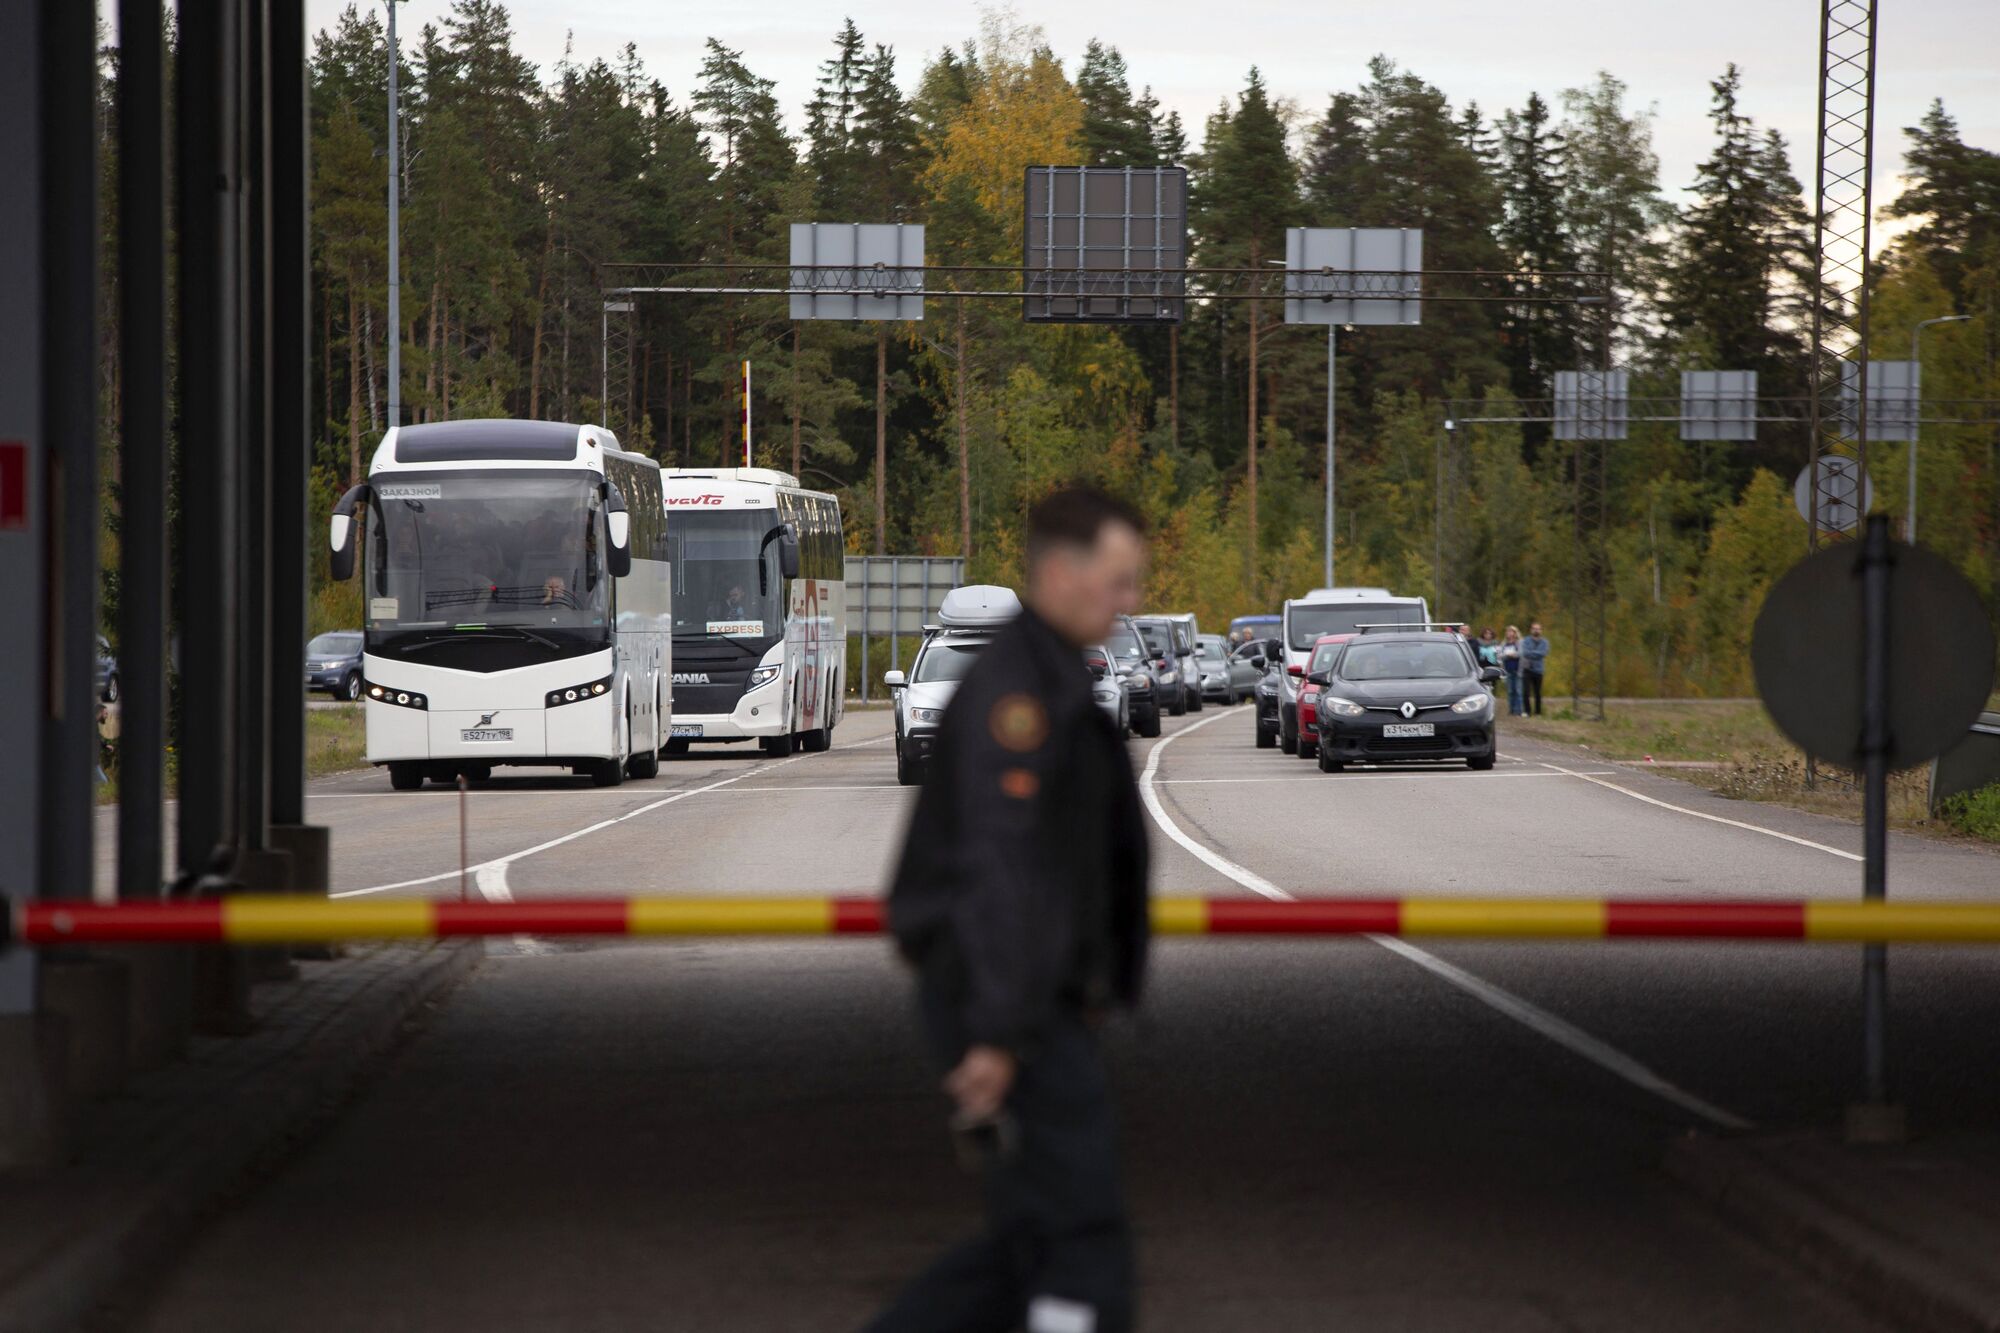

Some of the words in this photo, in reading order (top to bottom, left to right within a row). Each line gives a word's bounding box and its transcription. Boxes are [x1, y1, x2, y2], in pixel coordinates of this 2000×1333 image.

[380, 487, 440, 496] ЗАКАЗНОЙ
[709, 625, 762, 634] EXPRESS
[671, 673, 710, 684] ANIA
